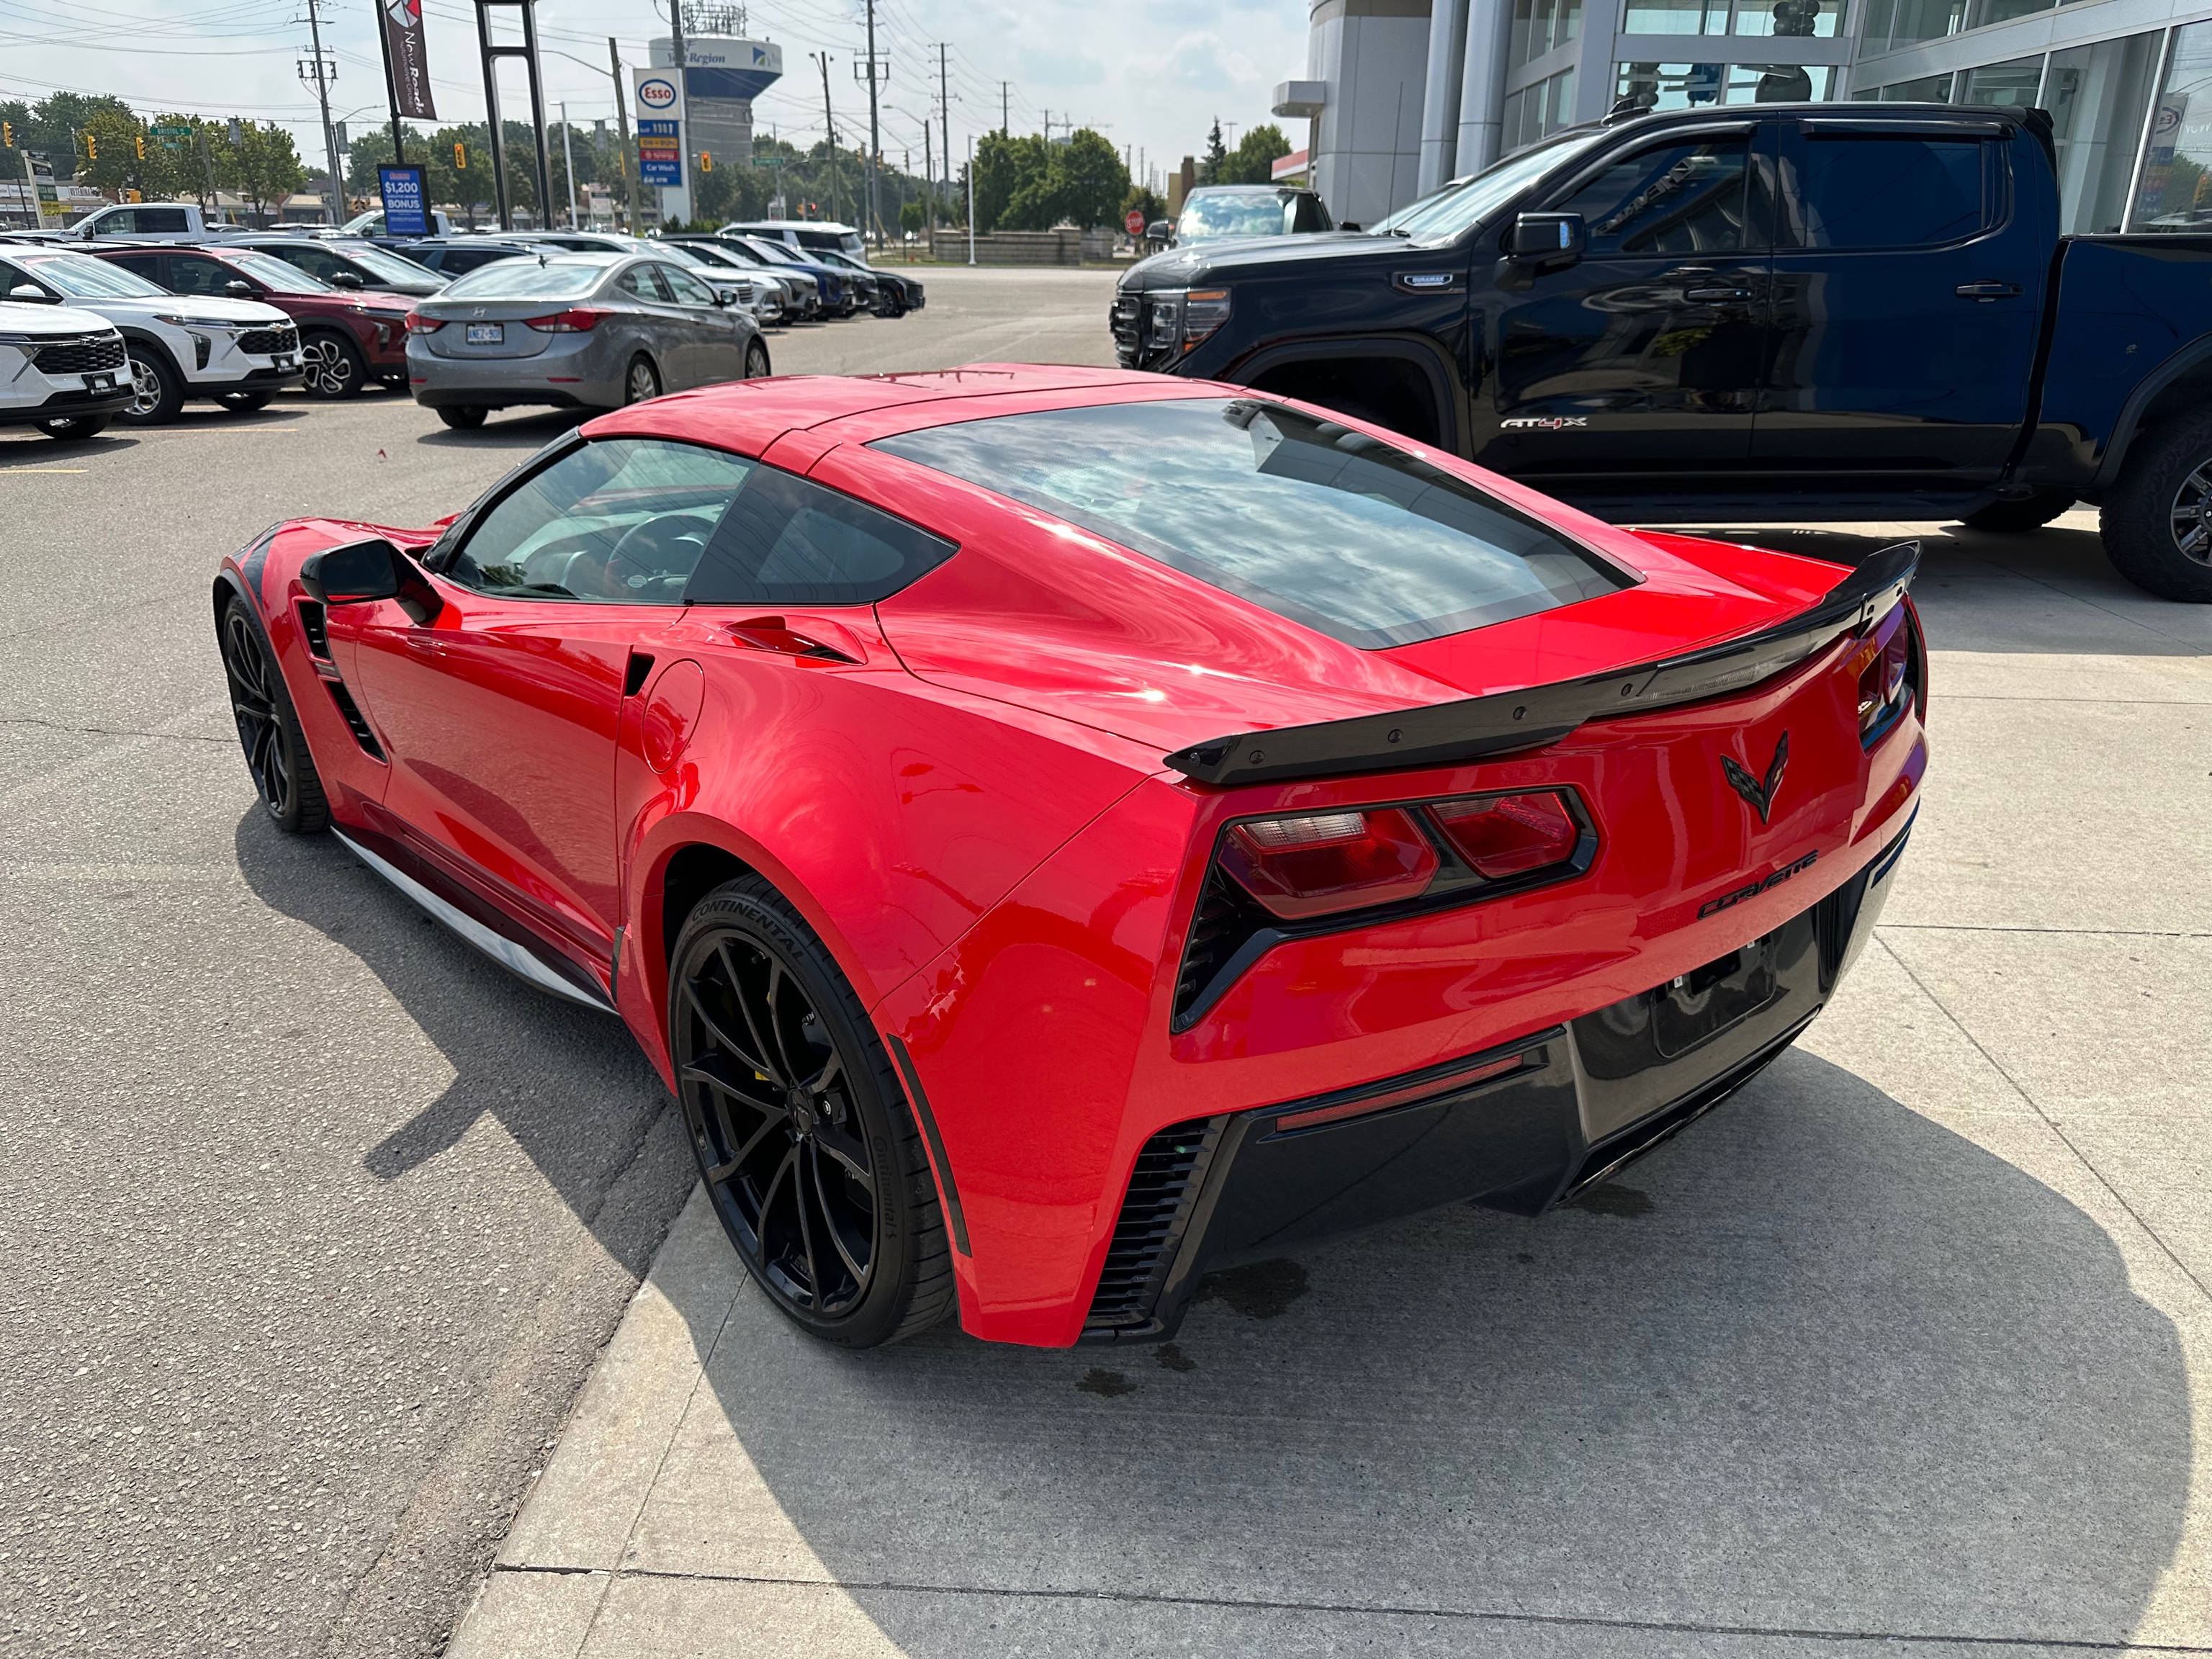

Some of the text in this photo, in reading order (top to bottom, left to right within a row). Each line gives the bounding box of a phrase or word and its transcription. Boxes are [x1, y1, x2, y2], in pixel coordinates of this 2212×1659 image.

[690, 53, 726, 66] Region
[404, 31, 424, 114] NewRoads
[405, 83, 414, 108] Group
[644, 86, 672, 99] Esso
[646, 163, 675, 172] Car Wash
[385, 181, 418, 194] $1,200
[387, 199, 421, 209] BONUS
[1125, 217, 1143, 229] STOP
[1500, 417, 1587, 430] AT4X
[1697, 849, 1819, 920] CORVETTE
[692, 899, 804, 966] CONTINENTAL
